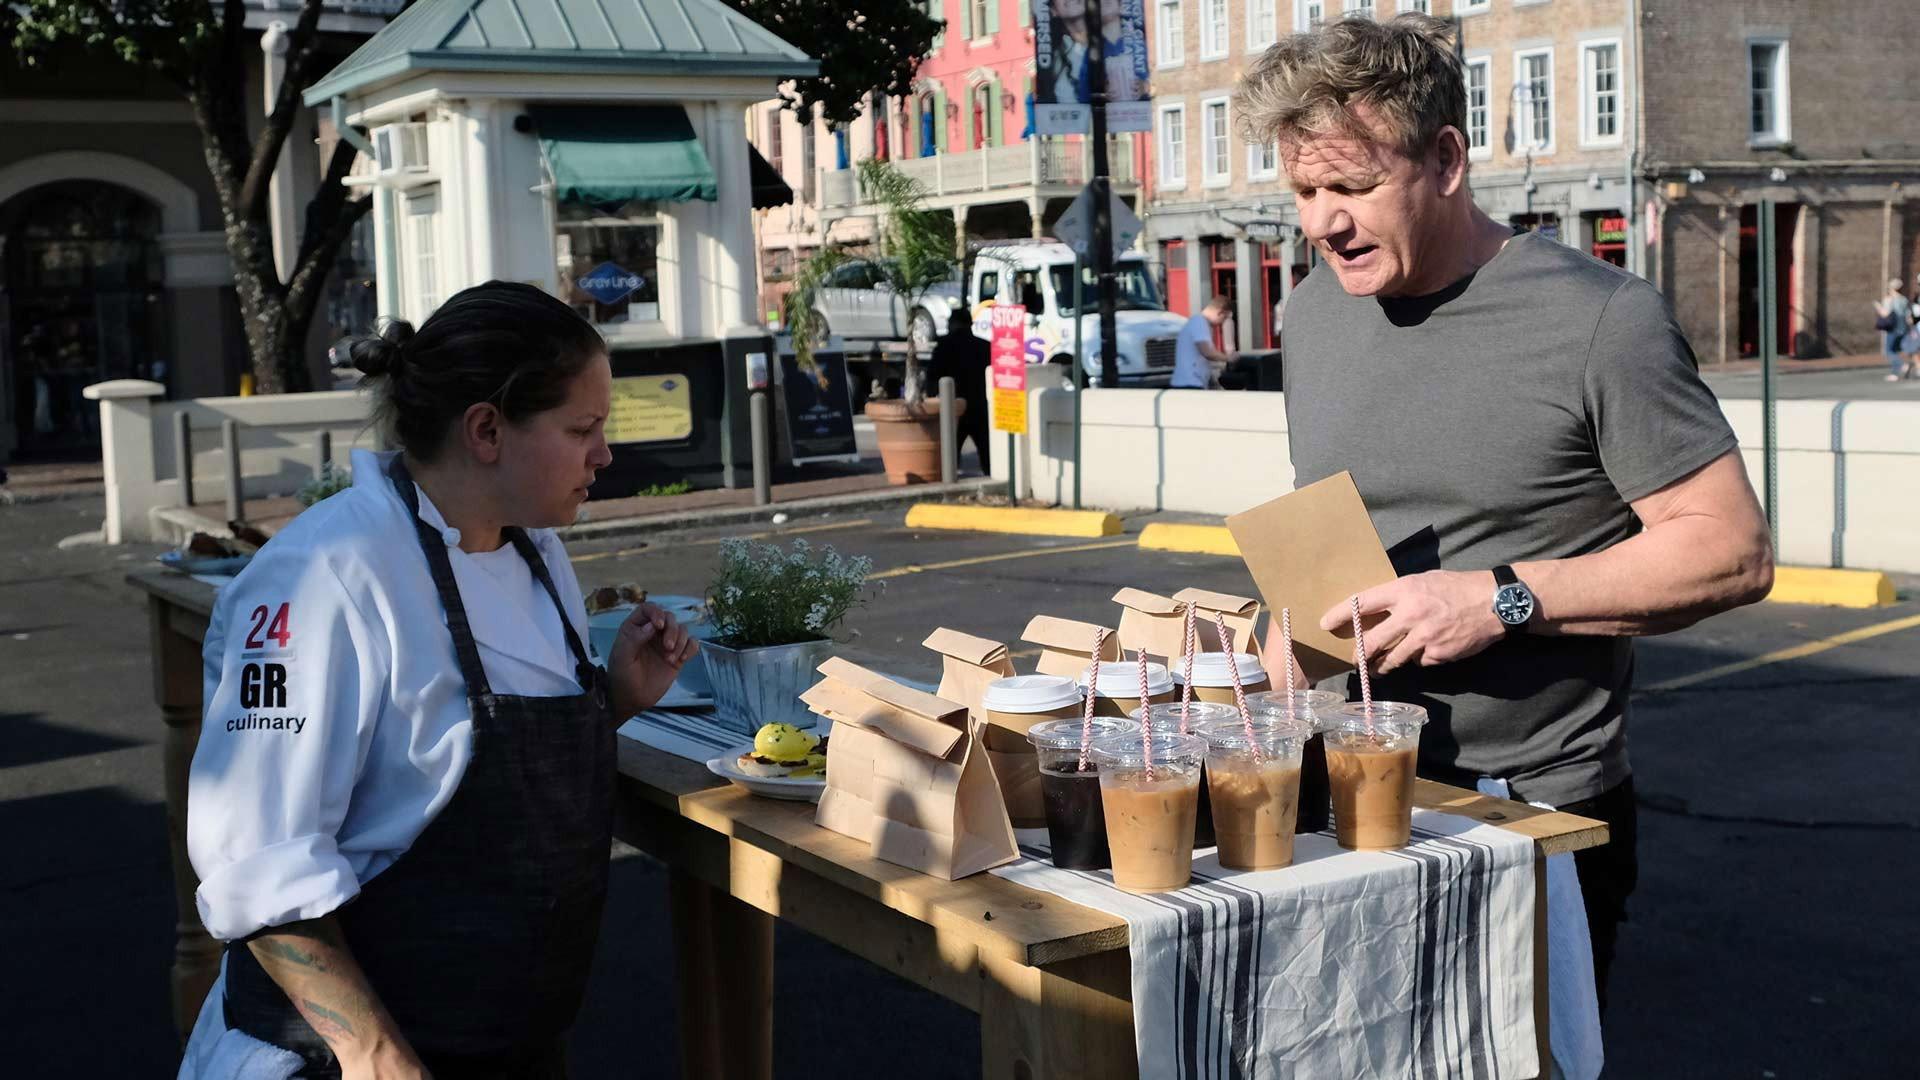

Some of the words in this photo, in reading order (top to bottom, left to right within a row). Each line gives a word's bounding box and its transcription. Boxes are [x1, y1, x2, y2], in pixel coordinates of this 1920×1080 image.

[1132, 28, 1146, 73] GIANT
[1246, 223, 1278, 236] GUMBO
[992, 307, 1022, 328] STOP
[245, 602, 290, 649] 24
[240, 662, 287, 709] GR
[226, 713, 307, 734] culinary
